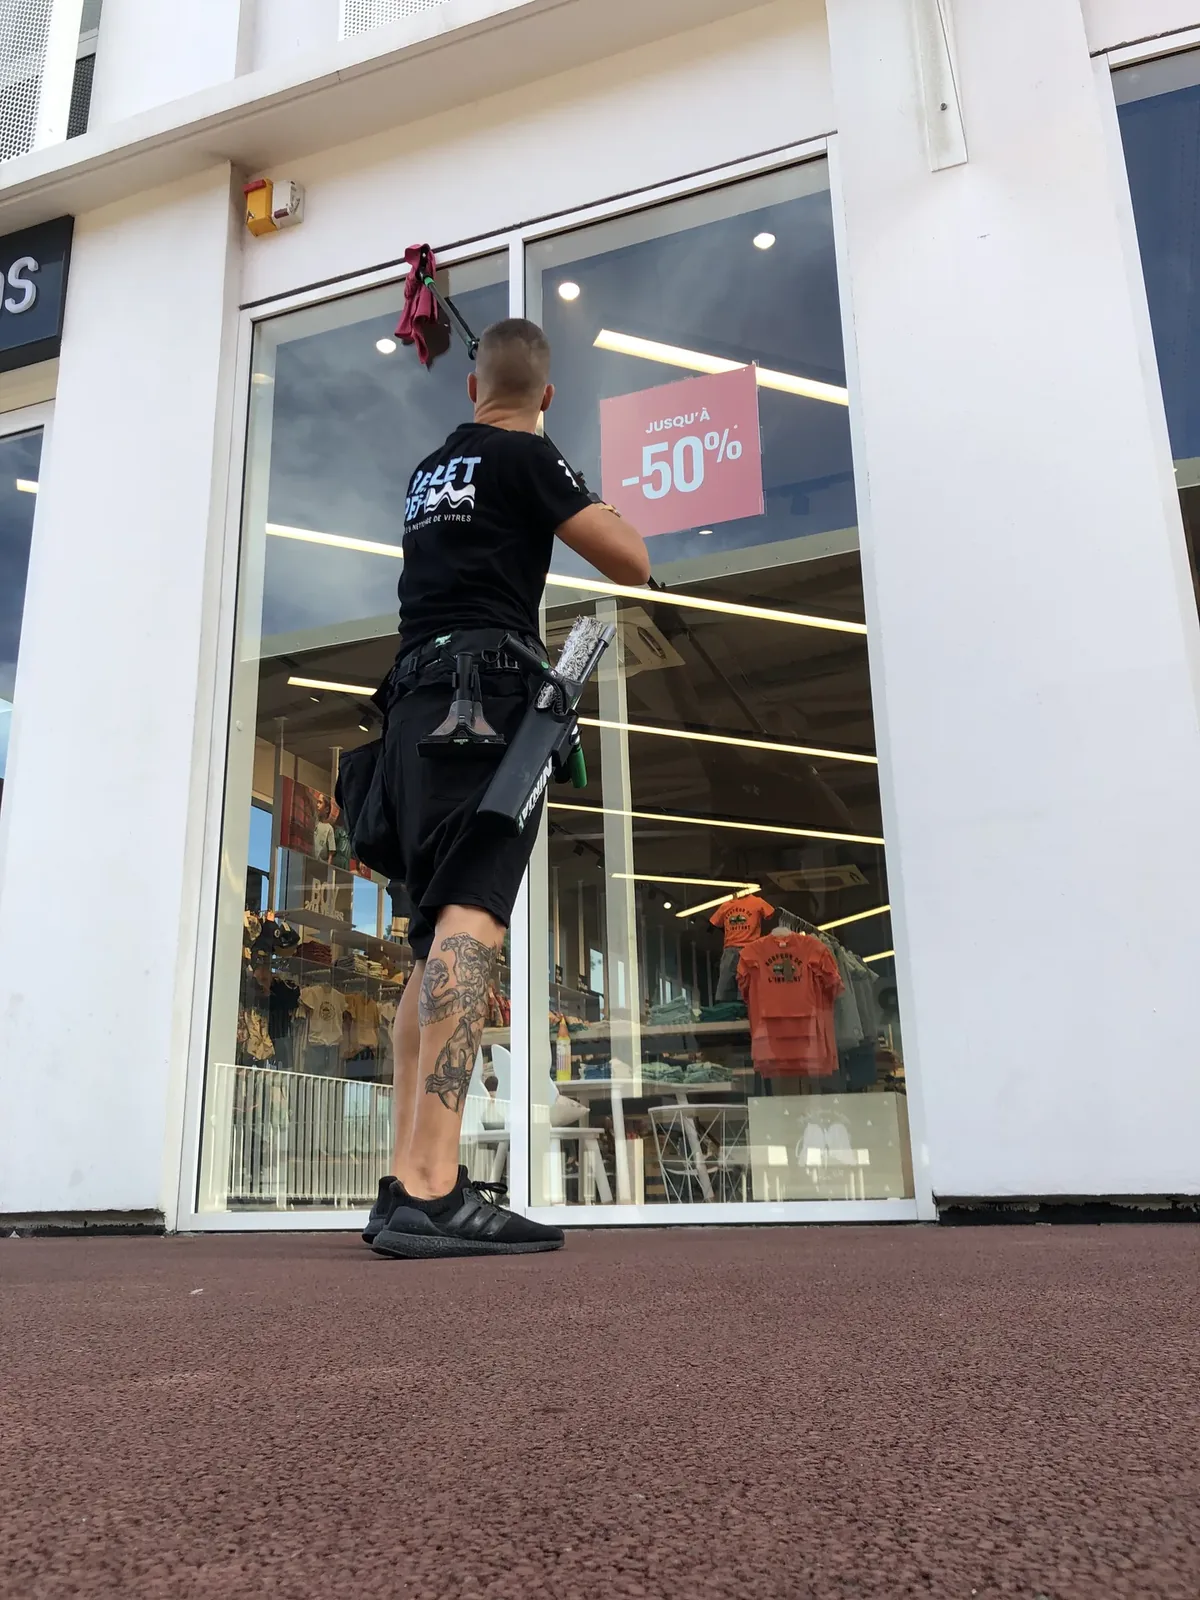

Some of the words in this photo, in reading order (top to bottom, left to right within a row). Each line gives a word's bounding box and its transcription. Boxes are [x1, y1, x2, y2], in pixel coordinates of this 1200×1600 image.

[0, 256, 39, 314] S
[645, 407, 710, 434] JUSQU'À
[433, 514, 441, 523] DE
[443, 514, 472, 523] VITRES
[768, 975, 801, 984] L'INSNT
